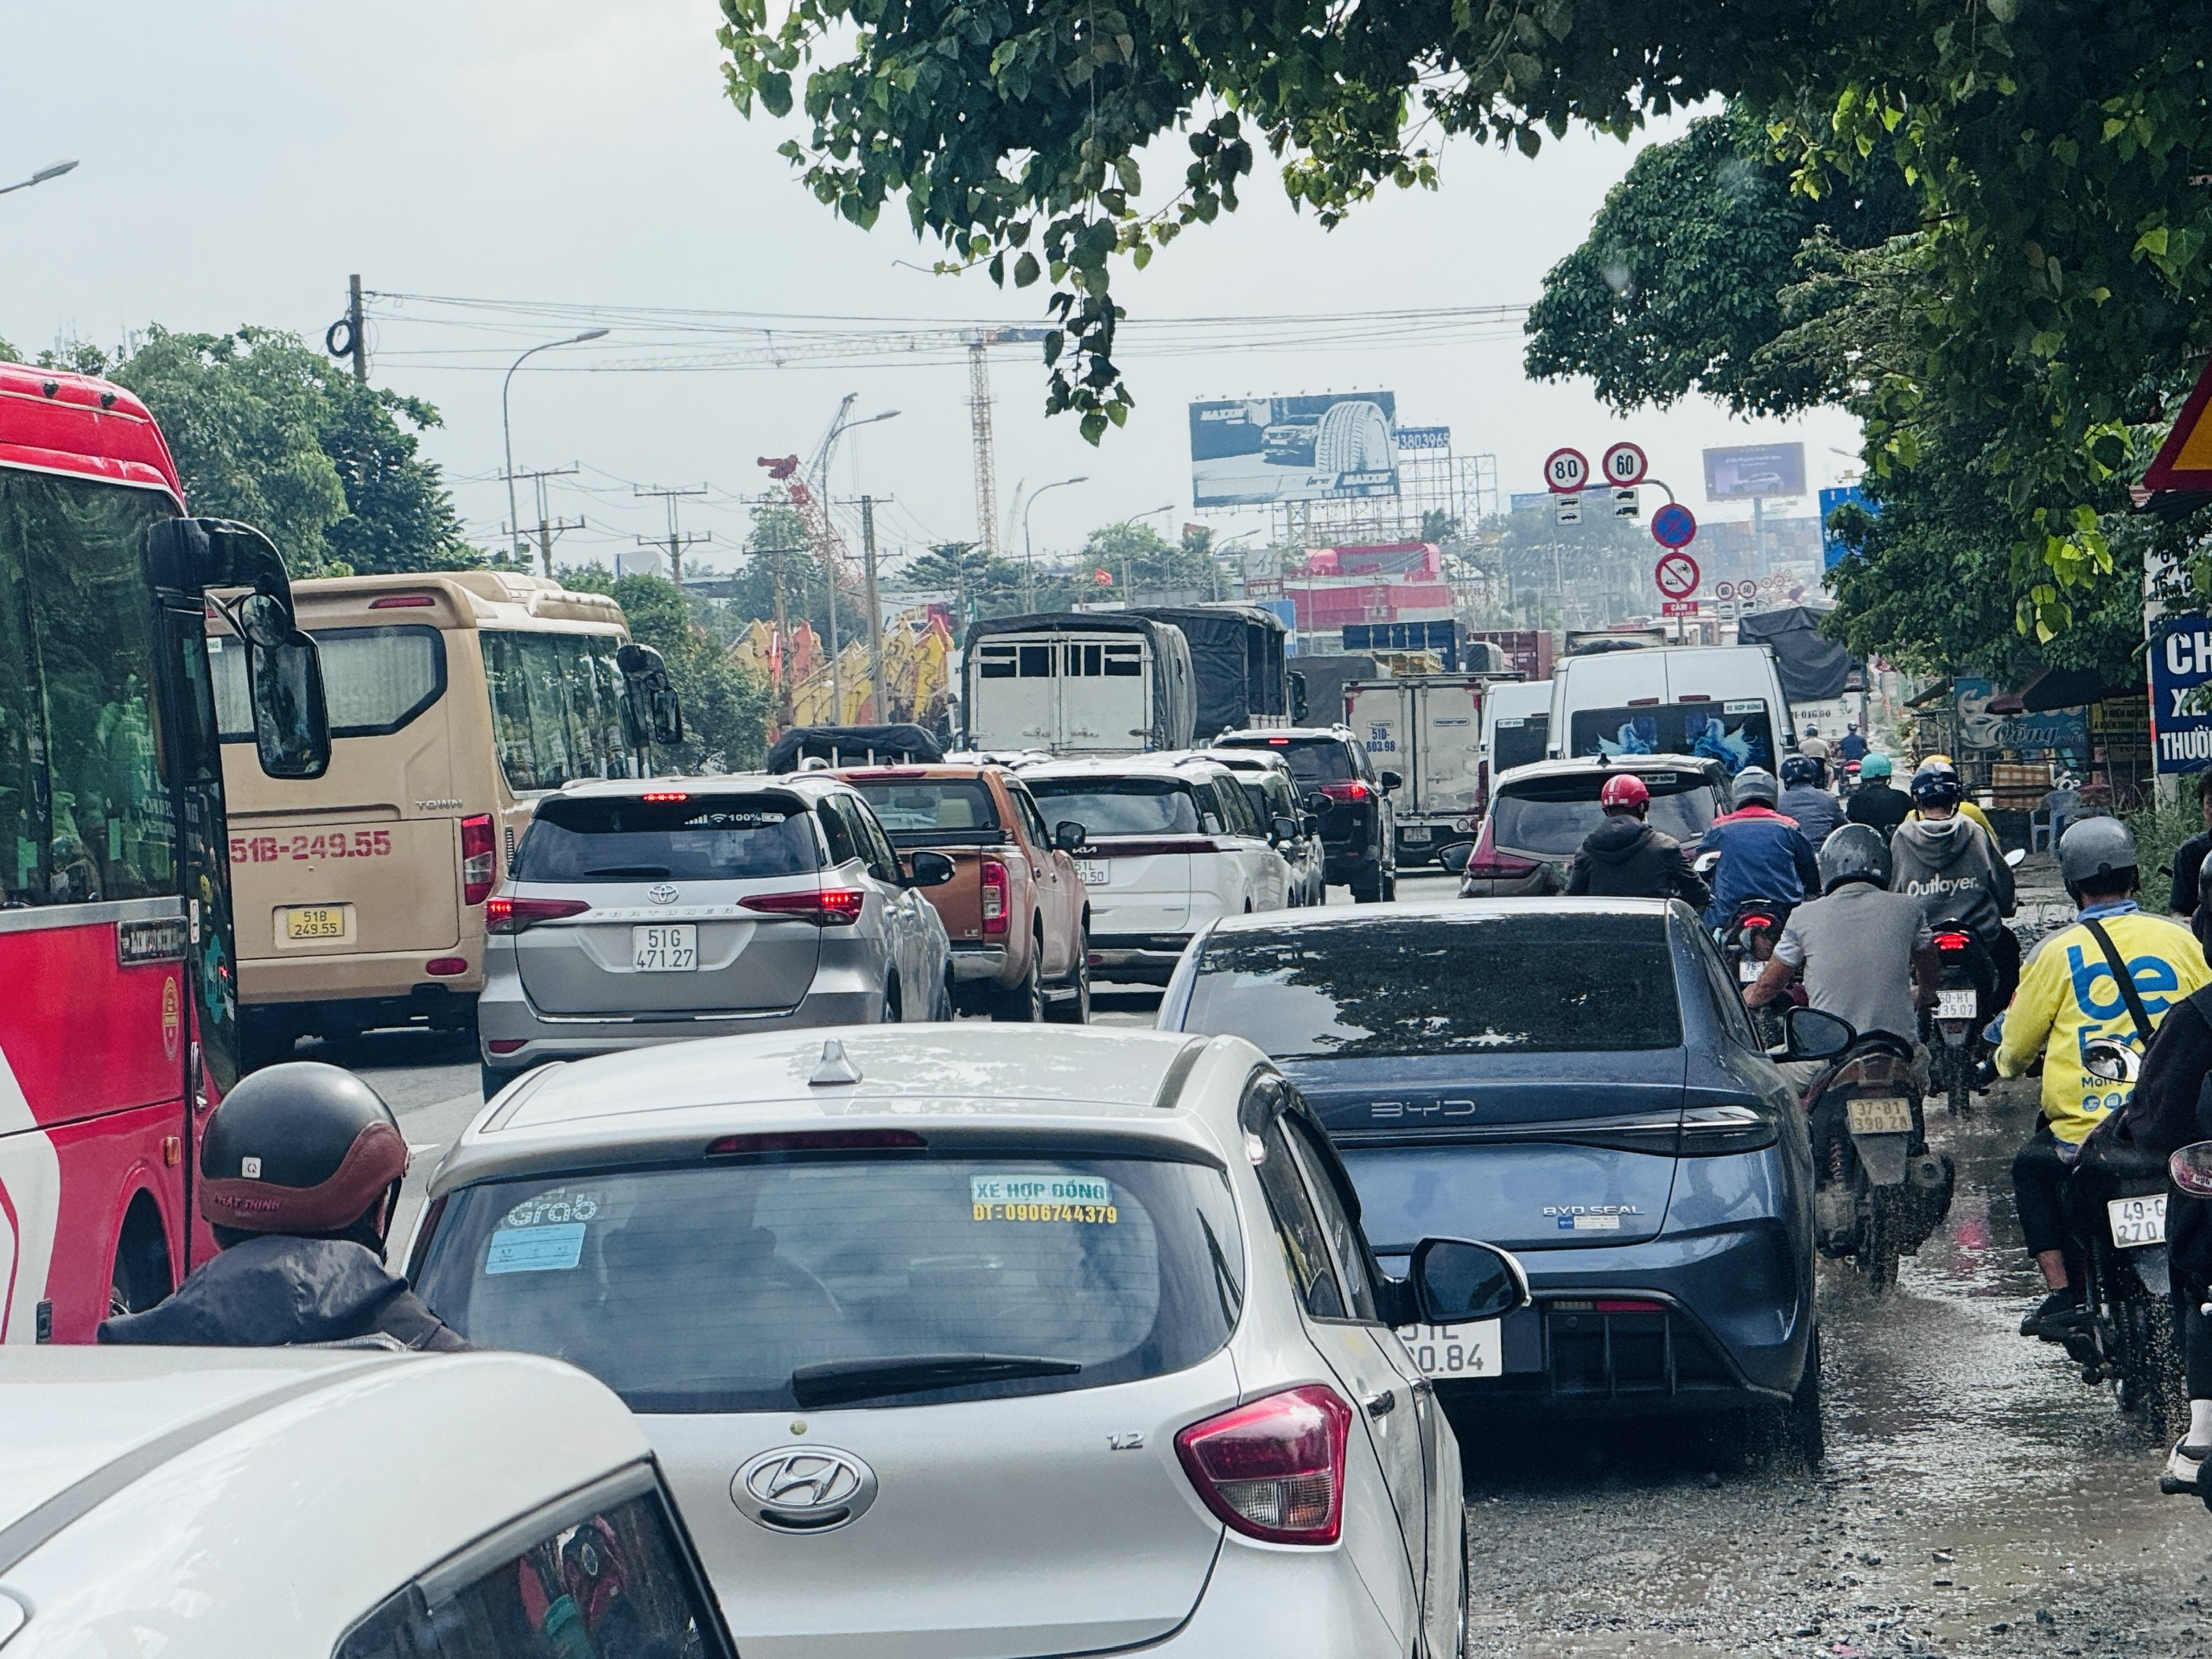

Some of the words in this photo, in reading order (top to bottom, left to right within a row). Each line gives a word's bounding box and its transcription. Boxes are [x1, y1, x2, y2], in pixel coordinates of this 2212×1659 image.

[1396, 432, 1450, 449] 3803965
[1555, 459, 1578, 480] 80
[1616, 454, 1634, 475] 60
[2160, 725, 2212, 760] THƯỜ
[416, 799, 463, 810] TOWN
[728, 813, 761, 822] 100%
[230, 830, 391, 863] 51B-249.55
[303, 910, 327, 923] 51B
[592, 907, 734, 918] FORTUNER
[295, 923, 337, 936] 249.55
[648, 929, 681, 948] 51G
[964, 929, 979, 938] LE
[636, 949, 694, 969] 471.27
[2066, 944, 2178, 1020] be
[1370, 1100, 1476, 1118] BYD
[976, 1183, 1001, 1198] XE
[1007, 1182, 1046, 1201] HỢP
[508, 1194, 597, 1226] Grab
[1542, 1206, 1586, 1217] BYD
[1590, 1205, 1645, 1216] SEAL
[1408, 1343, 1484, 1373] 0.84
[1106, 1430, 1146, 1451] 1.2
